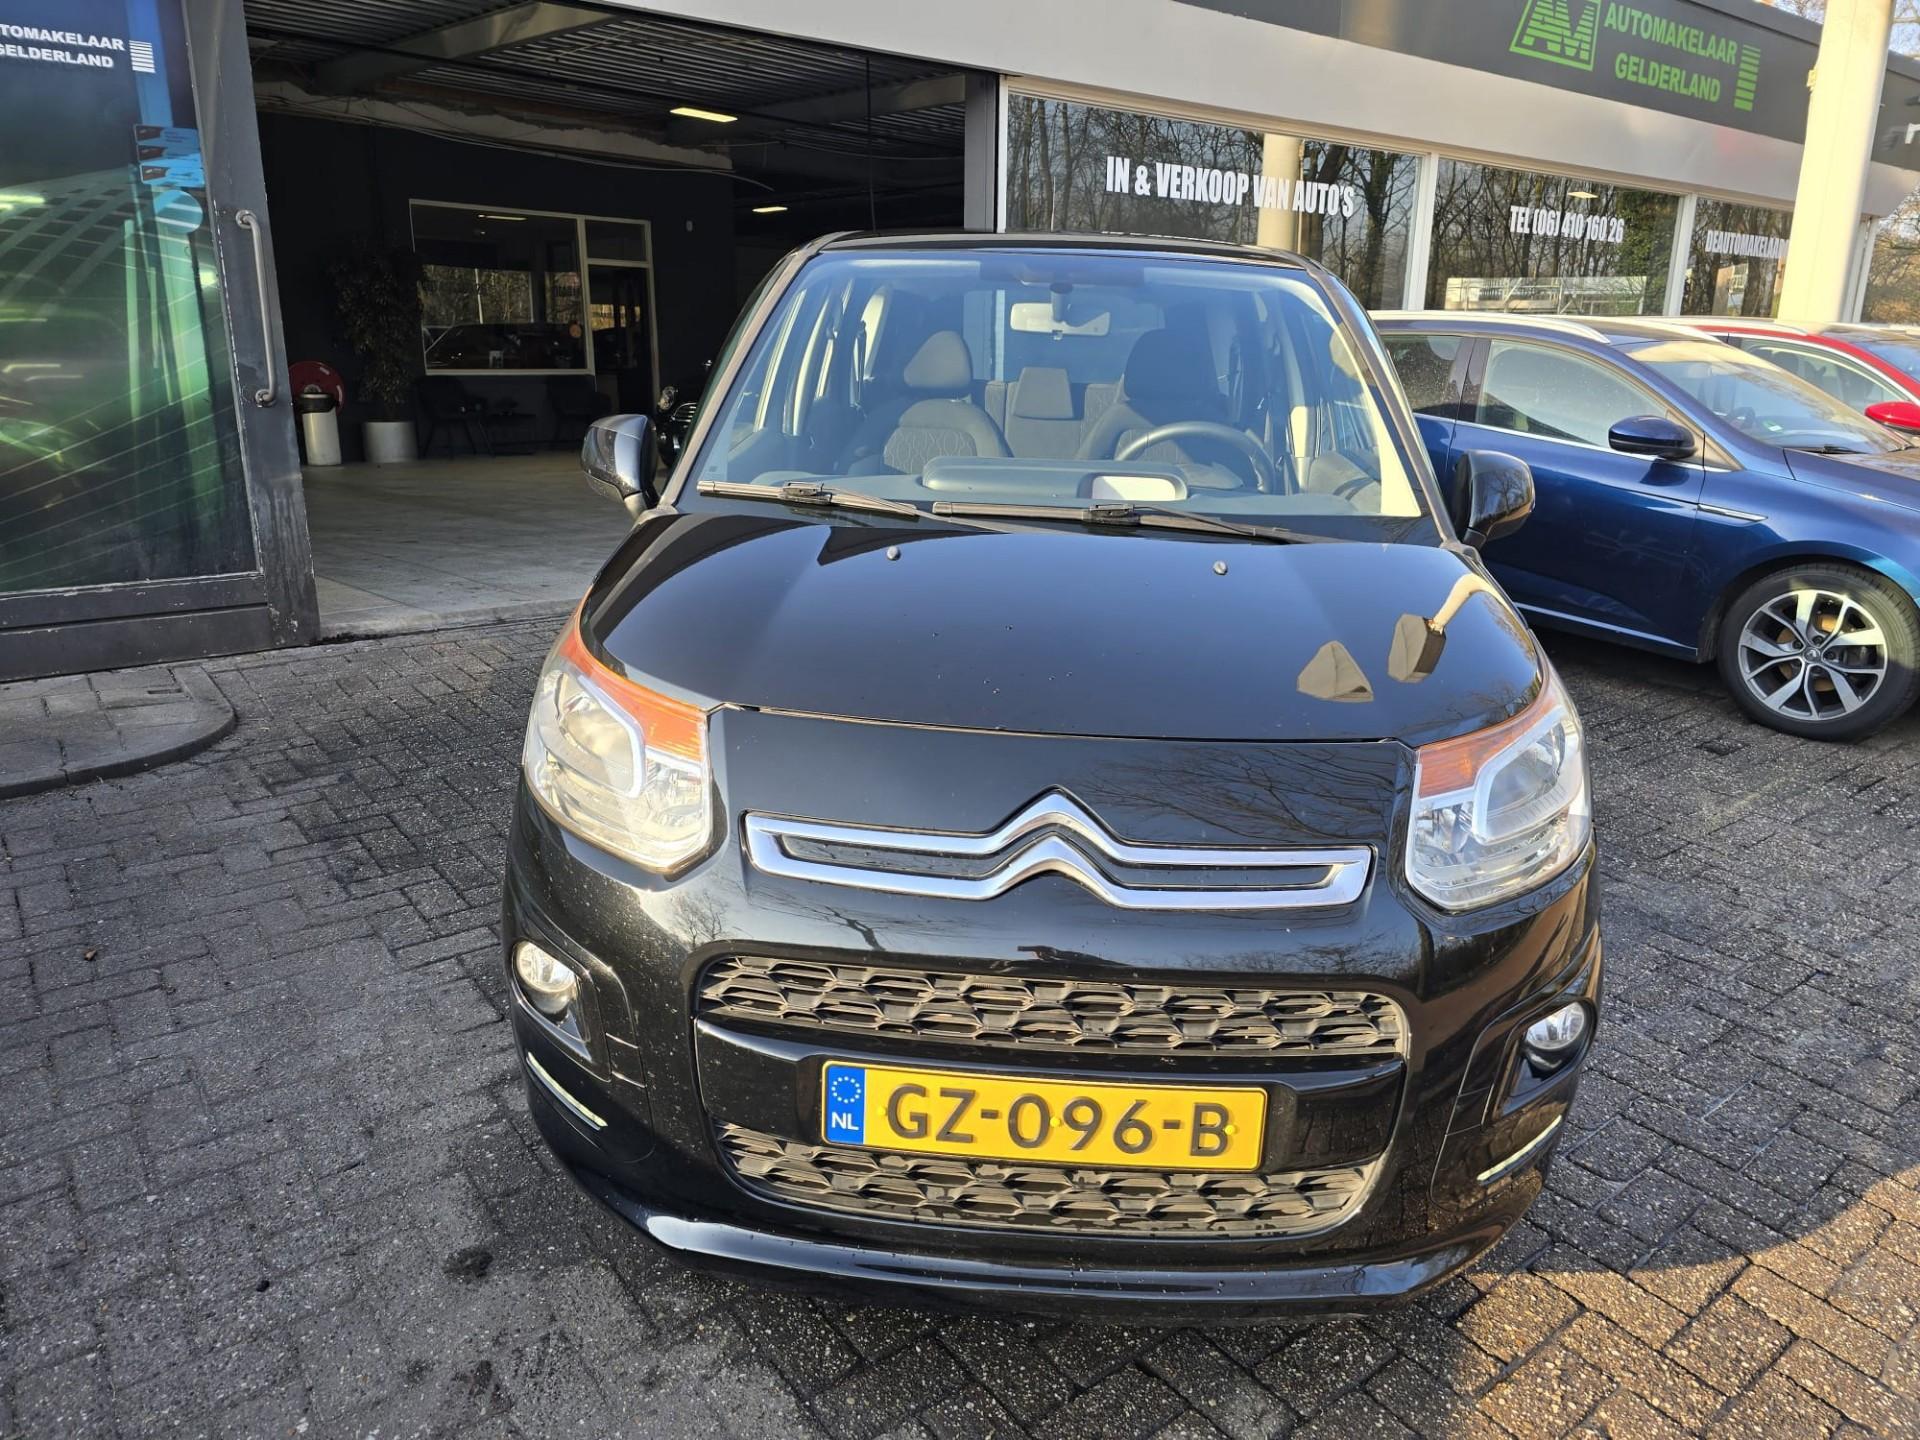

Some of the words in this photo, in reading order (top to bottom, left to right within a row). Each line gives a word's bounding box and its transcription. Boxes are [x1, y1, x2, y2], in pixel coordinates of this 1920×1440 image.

[1604, 2, 1738, 65] AUTOMAKELAAR
[1615, 52, 1721, 103] GELDERLAND
[1106, 156, 1130, 194] IN
[1134, 165, 1151, 196] &
[1155, 162, 1249, 206] VERKOOP
[1253, 175, 1290, 210] VAN
[1292, 180, 1355, 217] AUTO'S
[1509, 205, 1530, 234] TEL
[1532, 208, 1561, 237] (06)
[1561, 211, 1585, 240] 410
[1585, 214, 1608, 241] 160
[1608, 217, 1625, 243] 26
[831, 1110, 859, 1132] NL
[886, 1083, 1231, 1158] GZ-096-B
